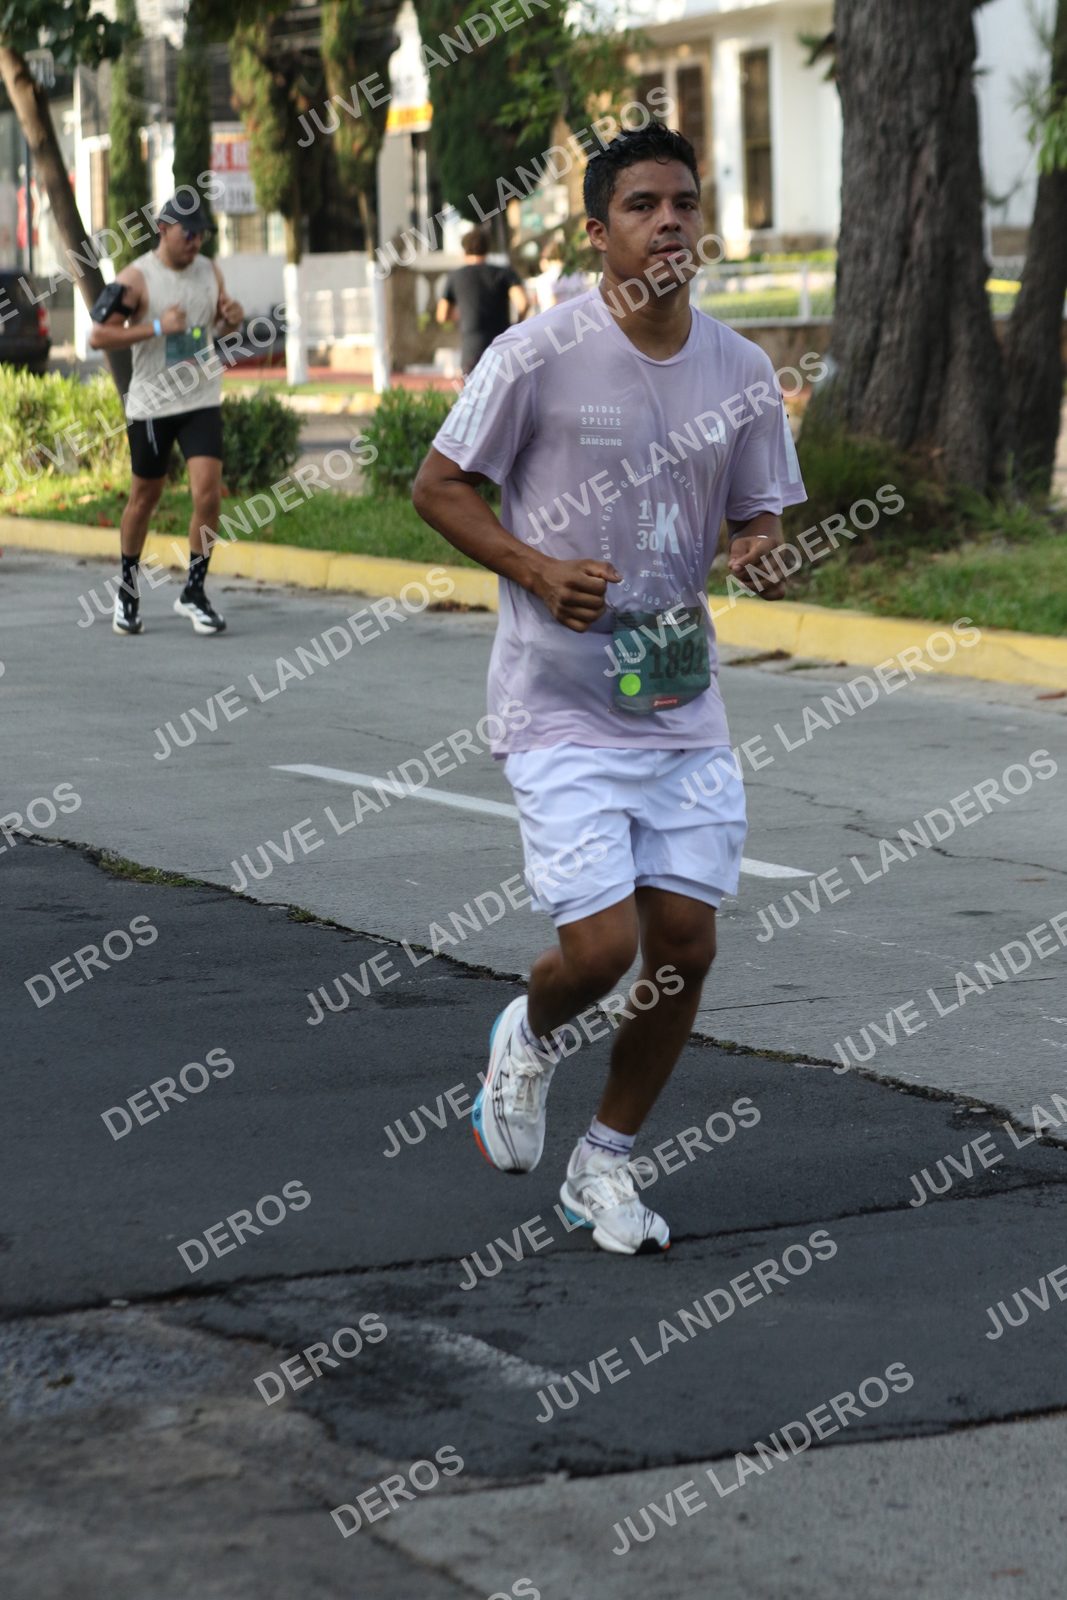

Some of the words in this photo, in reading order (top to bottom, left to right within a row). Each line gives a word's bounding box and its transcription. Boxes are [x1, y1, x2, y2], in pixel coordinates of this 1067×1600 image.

[580, 405, 621, 414] ADIDAS
[582, 417, 621, 426] SPLITS
[580, 437, 622, 447] SAMSUNG
[656, 502, 681, 554] K
